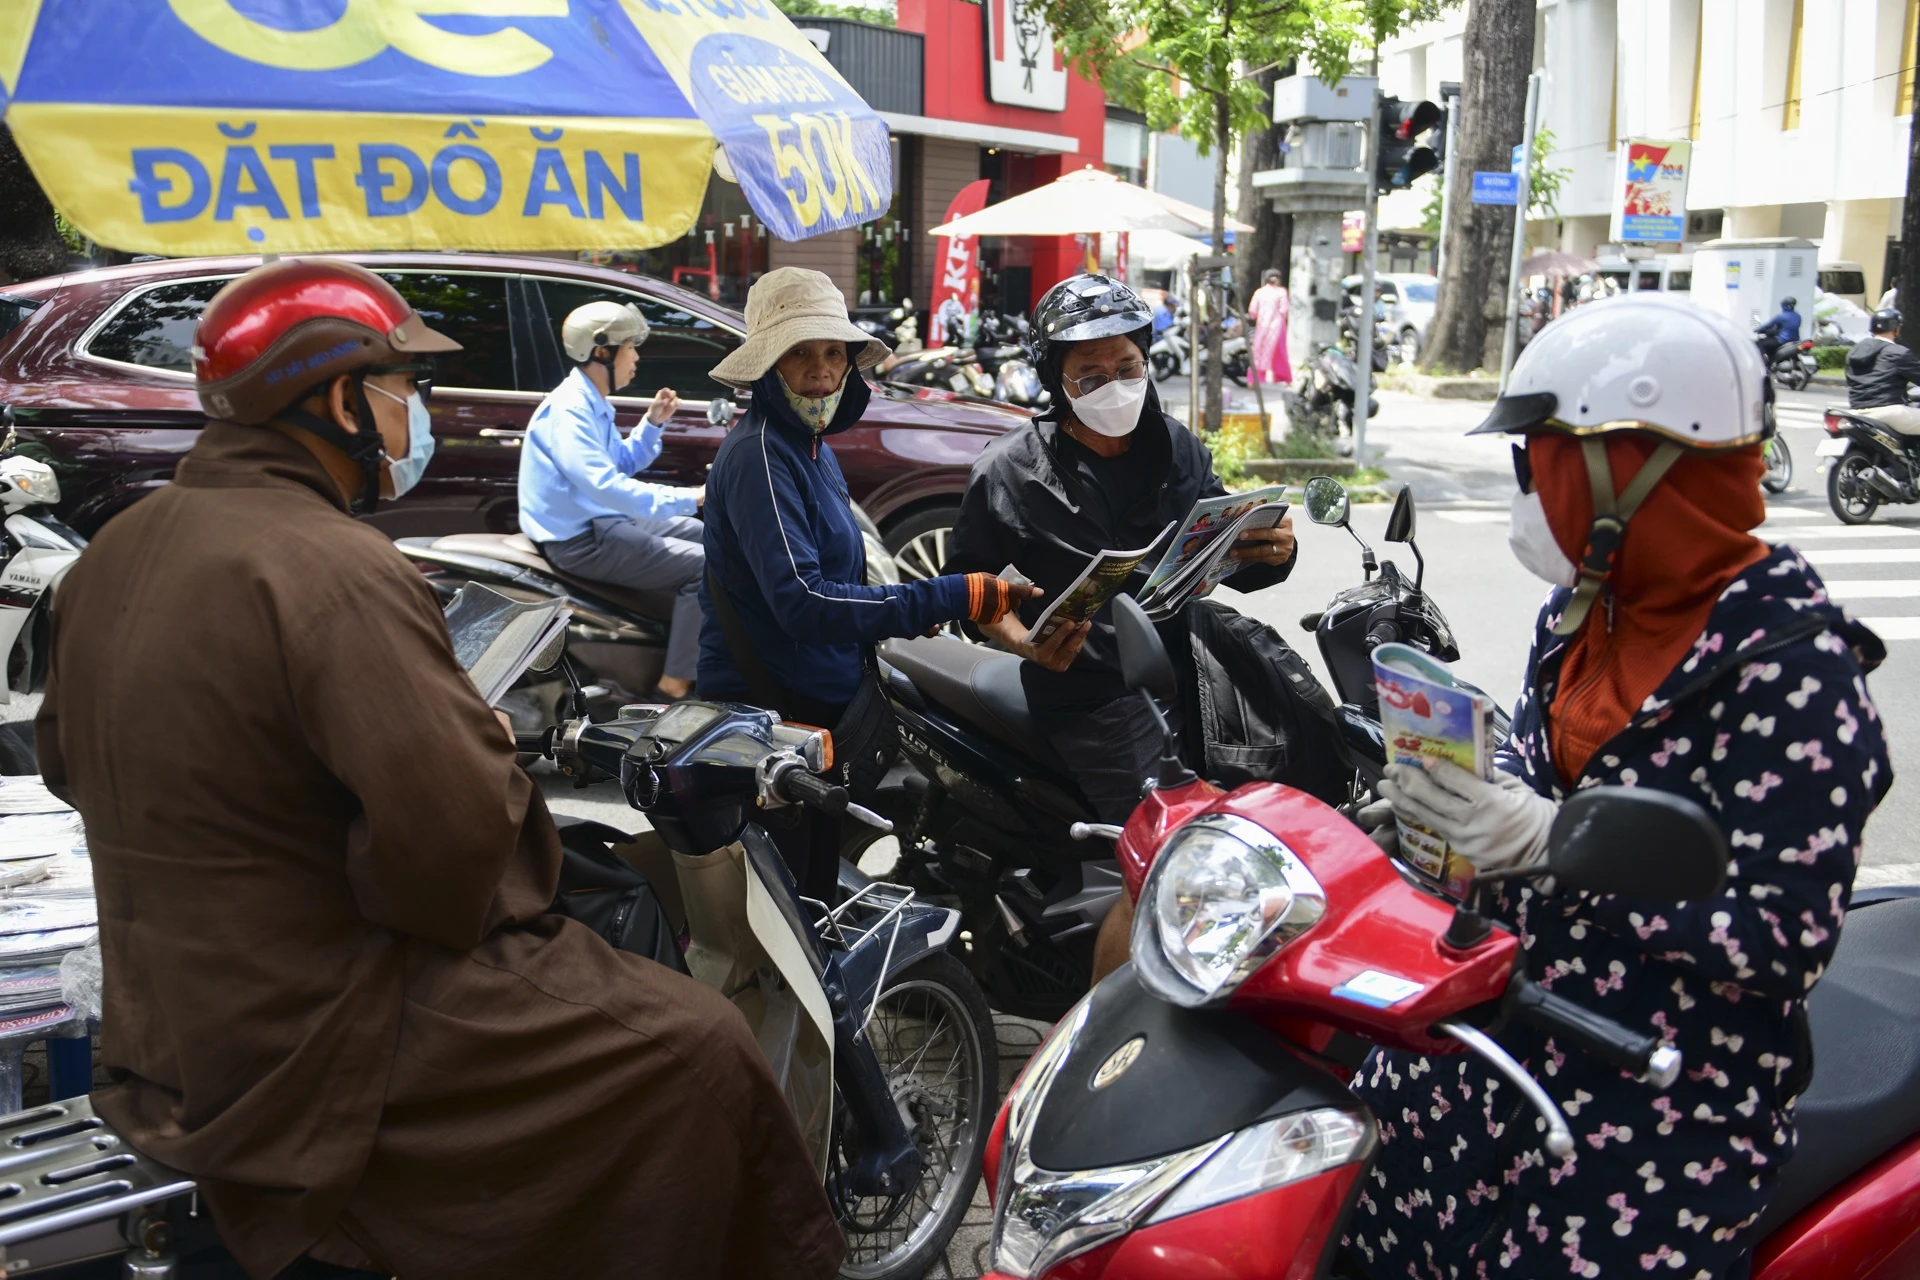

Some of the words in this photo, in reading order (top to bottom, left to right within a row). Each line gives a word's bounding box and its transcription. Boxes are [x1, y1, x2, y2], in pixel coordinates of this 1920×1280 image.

[128, 121, 335, 243] ĐẶT
[355, 117, 502, 217] ĐỒ
[522, 126, 645, 222] ĂN
[752, 112, 880, 228] 50K
[9, 573, 41, 585] YAMAHA
[0, 1007, 68, 1029] KinhteSa
